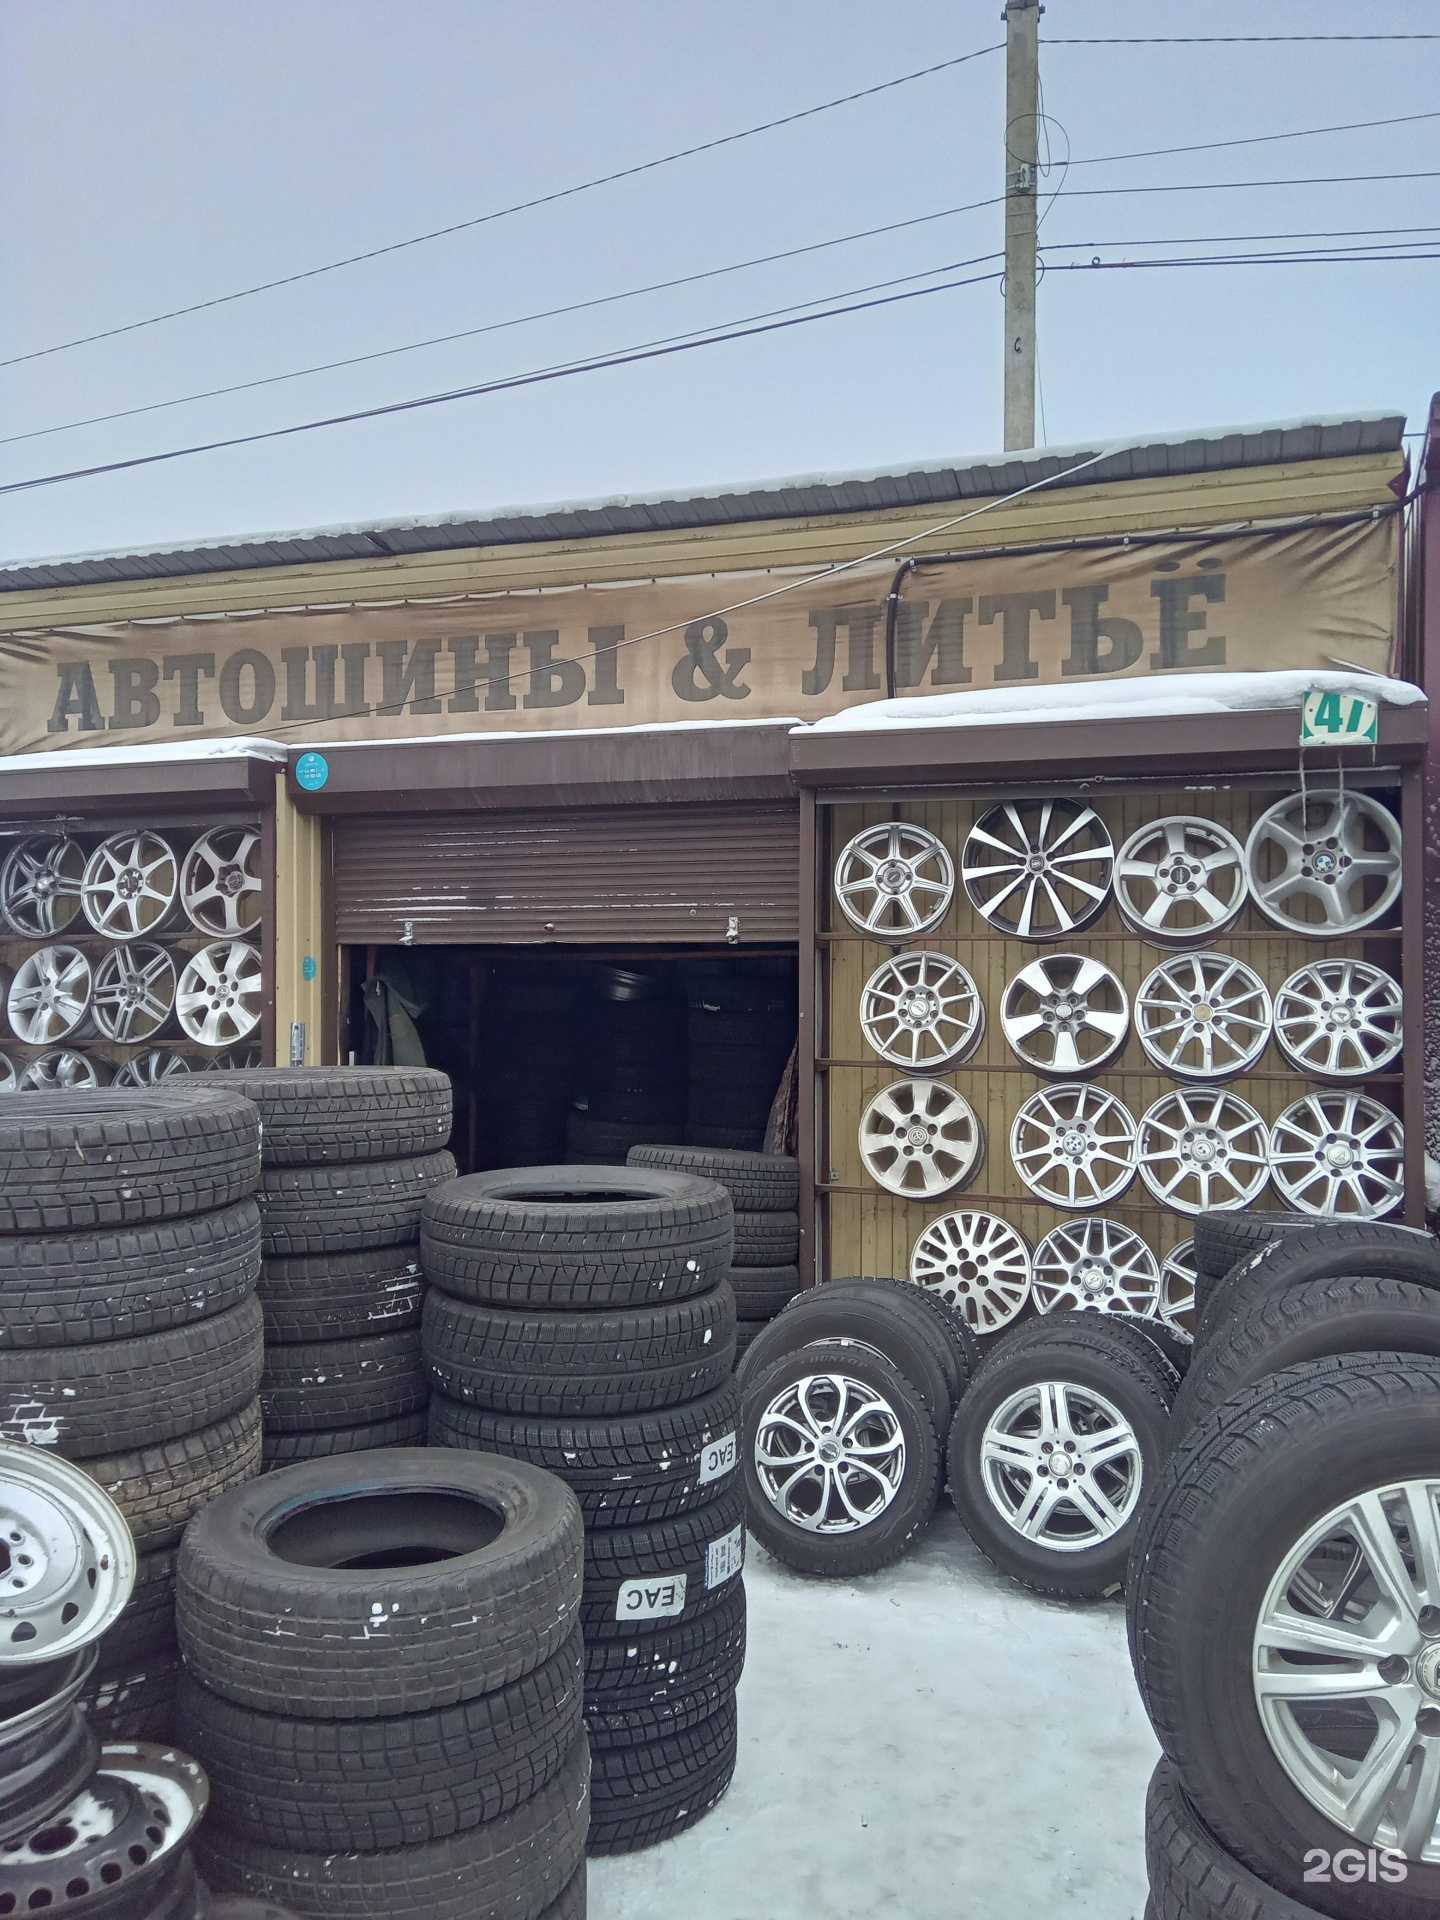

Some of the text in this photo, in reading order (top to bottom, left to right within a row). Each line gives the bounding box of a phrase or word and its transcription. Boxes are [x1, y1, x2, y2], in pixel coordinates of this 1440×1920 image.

[47, 556, 1227, 732] АВТОШИНЫ & ЛИТЬЁ
[626, 1585, 676, 1611] EAC
